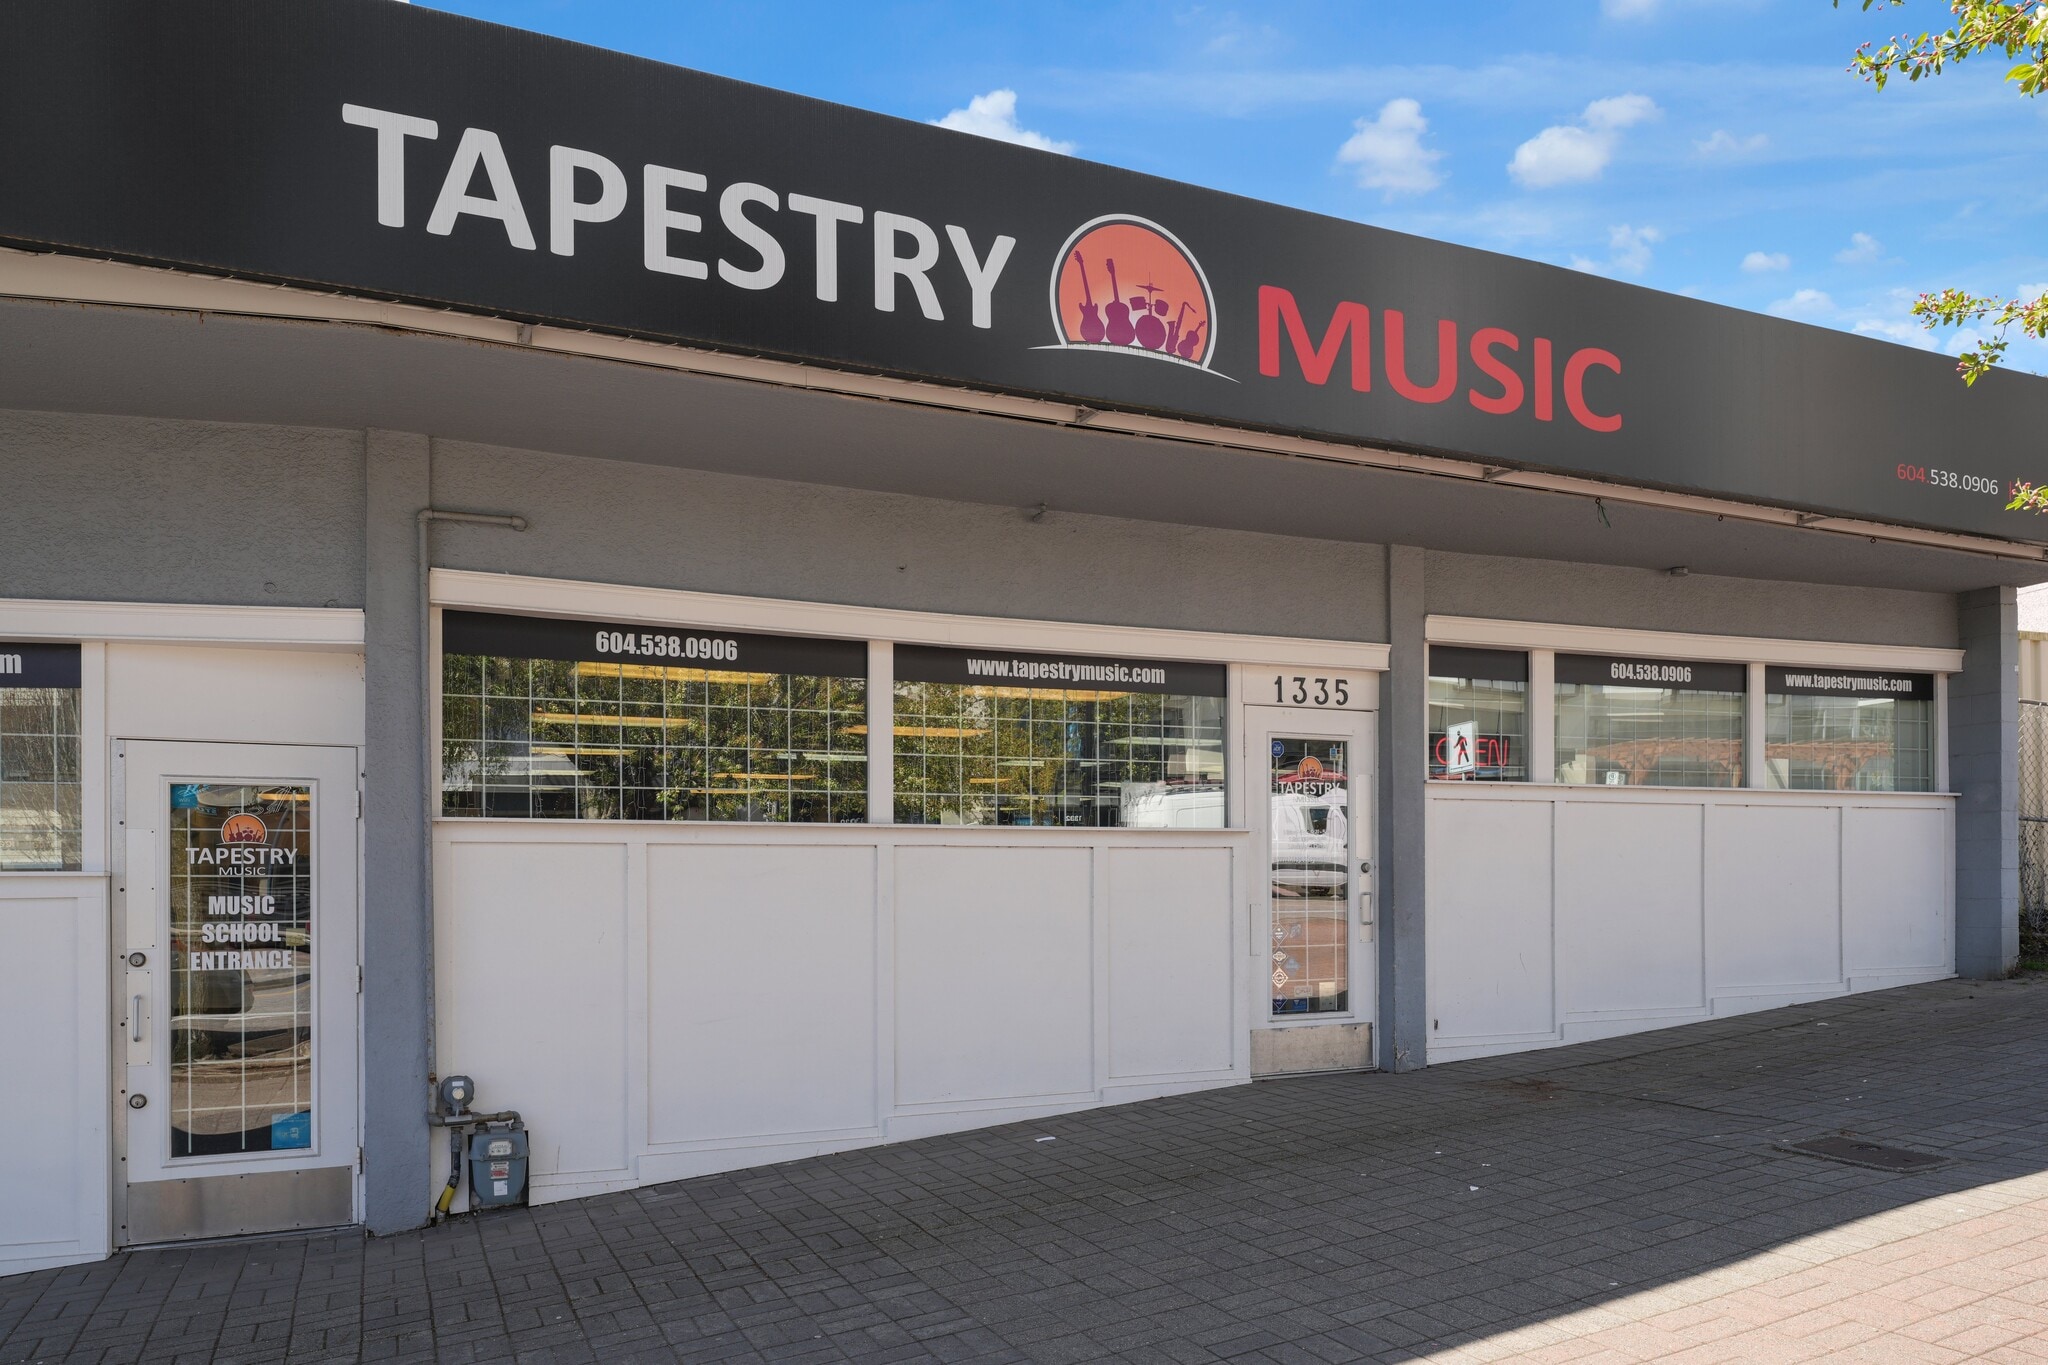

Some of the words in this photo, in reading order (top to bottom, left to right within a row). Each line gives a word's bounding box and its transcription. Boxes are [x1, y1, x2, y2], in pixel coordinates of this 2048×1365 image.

[341, 102, 1017, 330] TAPESTRY
[1257, 284, 1623, 433] MUSIC
[1896, 463, 1999, 495] 604.538.0906
[595, 630, 738, 661] 604.538.0906
[967, 657, 1165, 684] www.tapestrymusic.com
[1610, 662, 1692, 684] 604.538.0906
[1274, 675, 1350, 706] 1335
[1785, 672, 1913, 693] www.tapestrymusic.com
[1435, 736, 1508, 767] OEN
[1278, 781, 1340, 795] TAPESTRY
[185, 847, 298, 865] TAPESTRY
[219, 866, 267, 876] MUSIC
[208, 895, 275, 915] MUSIC
[201, 923, 282, 943] SCHOOL
[189, 950, 293, 971] ENTRANCE
